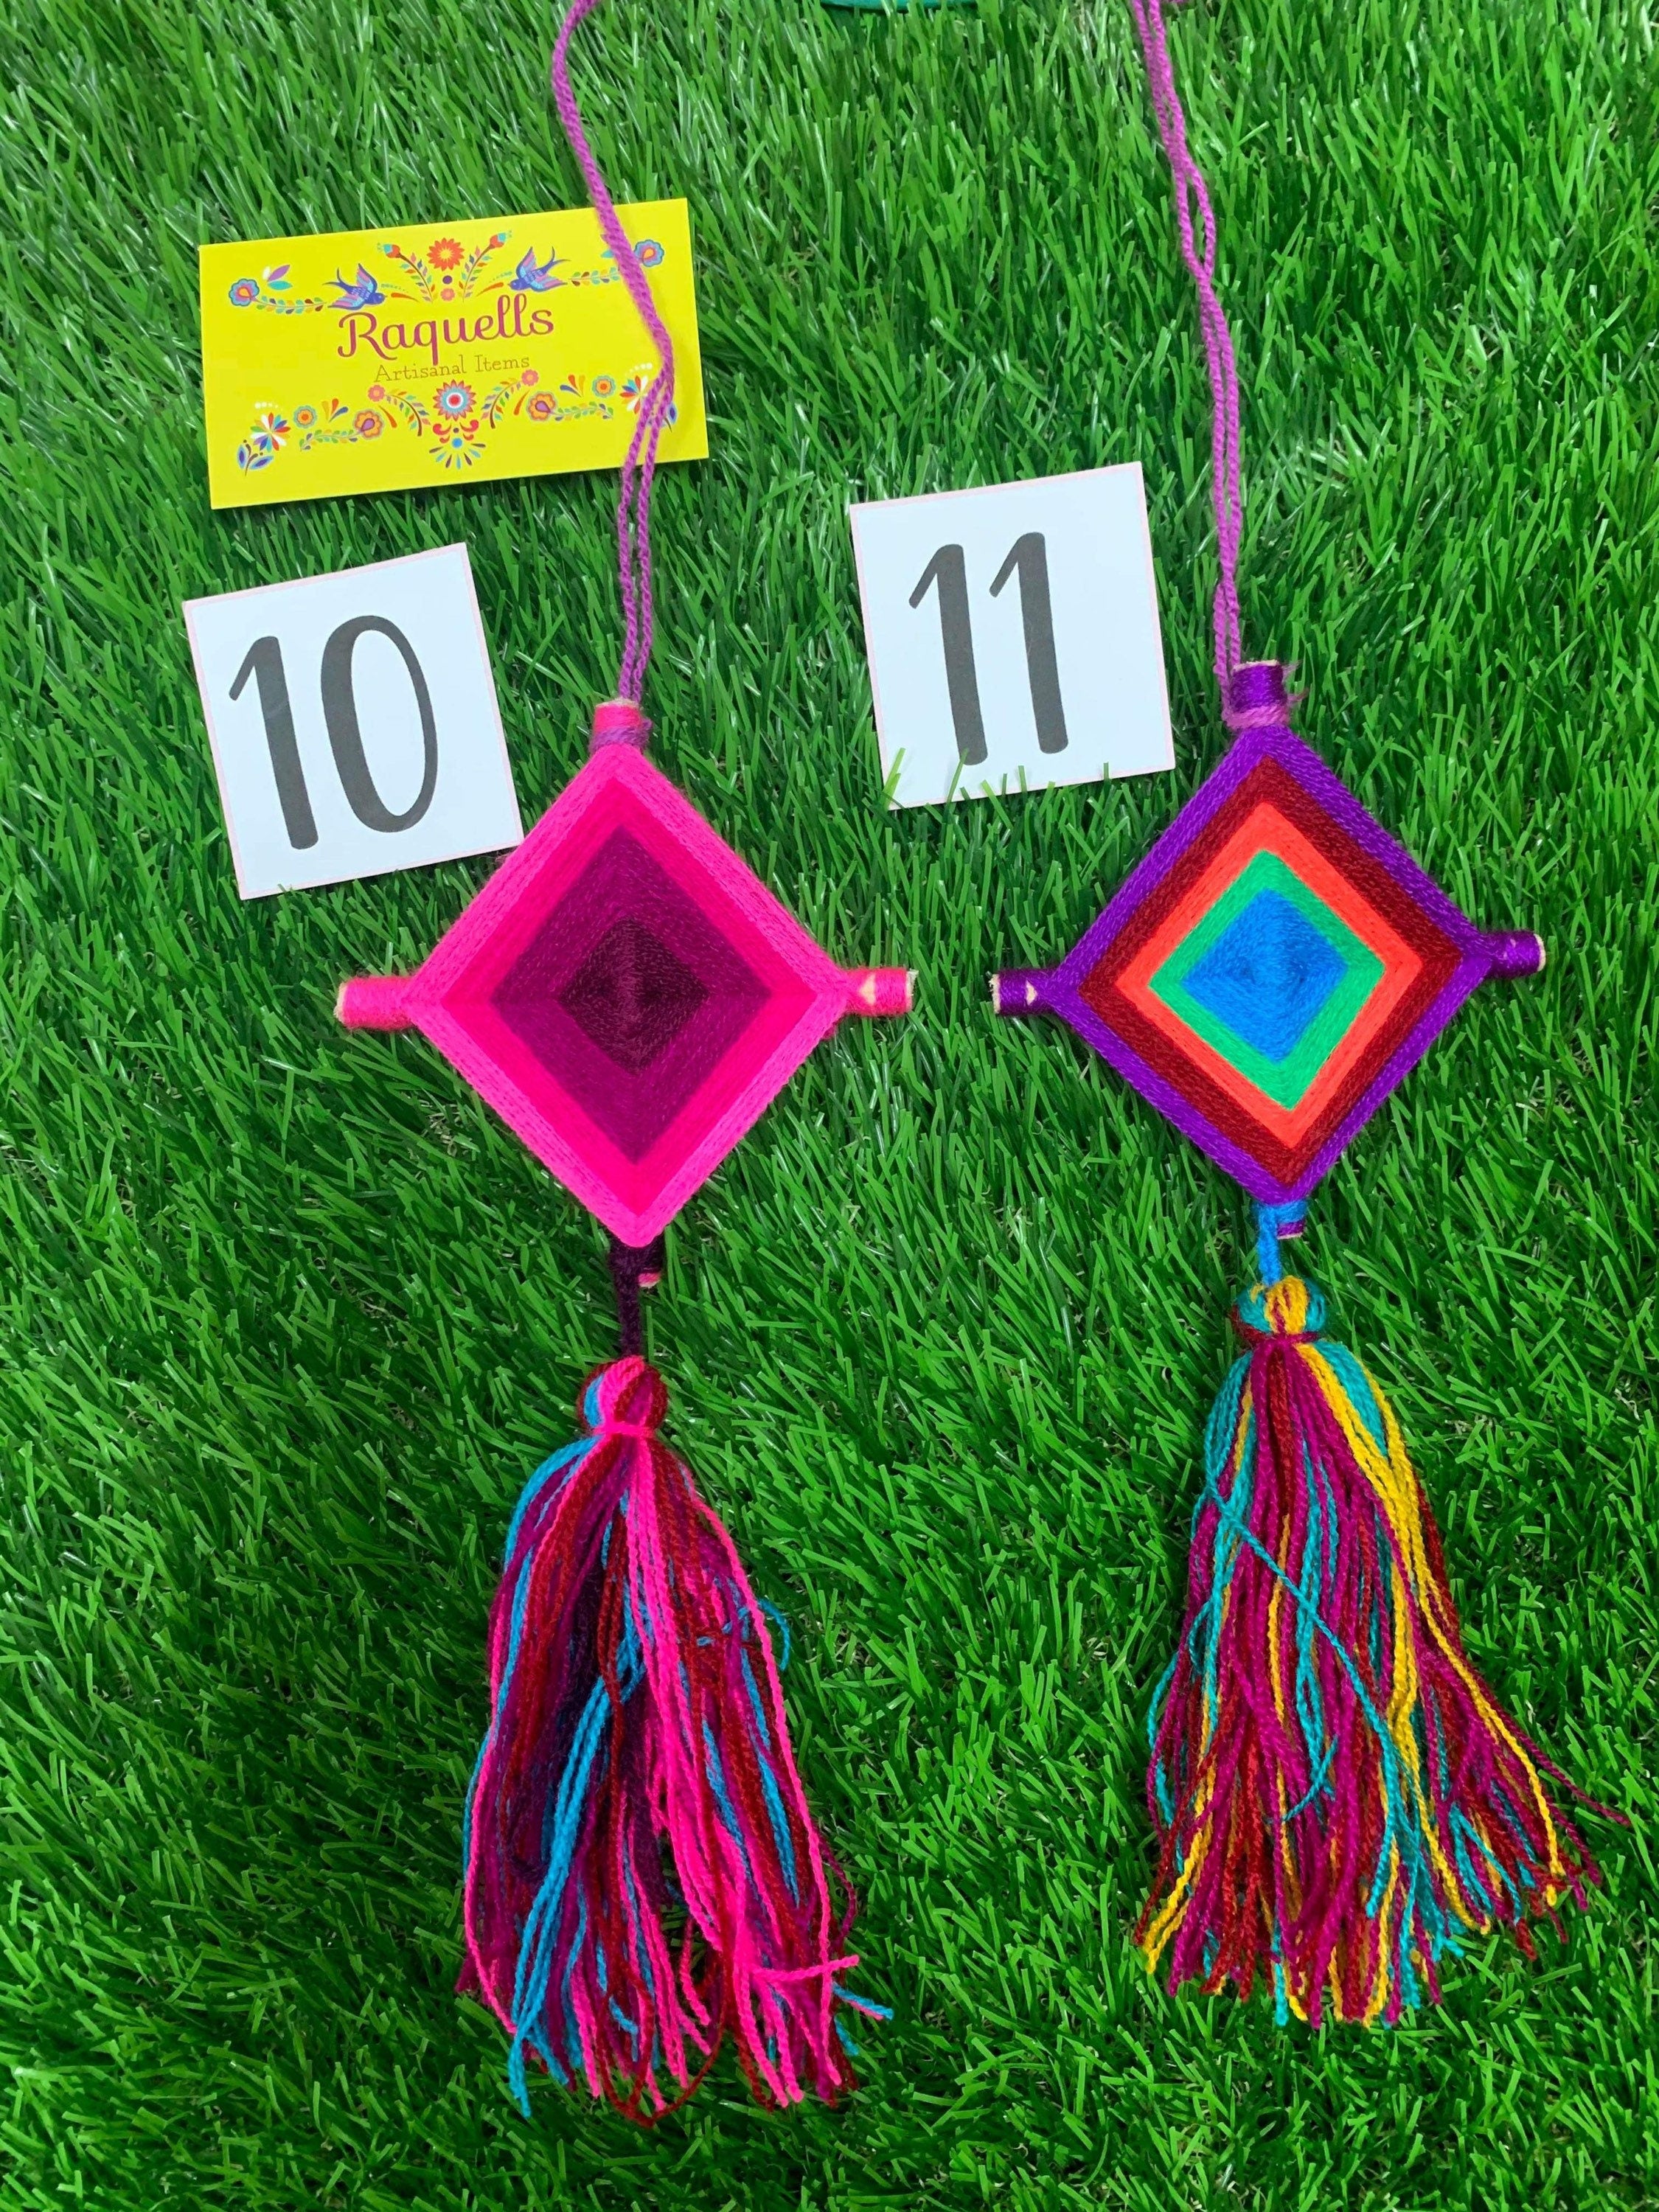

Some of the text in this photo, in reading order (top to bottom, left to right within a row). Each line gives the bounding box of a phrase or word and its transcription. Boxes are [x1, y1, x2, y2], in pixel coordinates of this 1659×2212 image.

[337, 293, 554, 366] Raquells
[373, 355, 530, 383] Artisanal Items
[908, 532, 1069, 766] 11
[229, 615, 438, 850] 10
